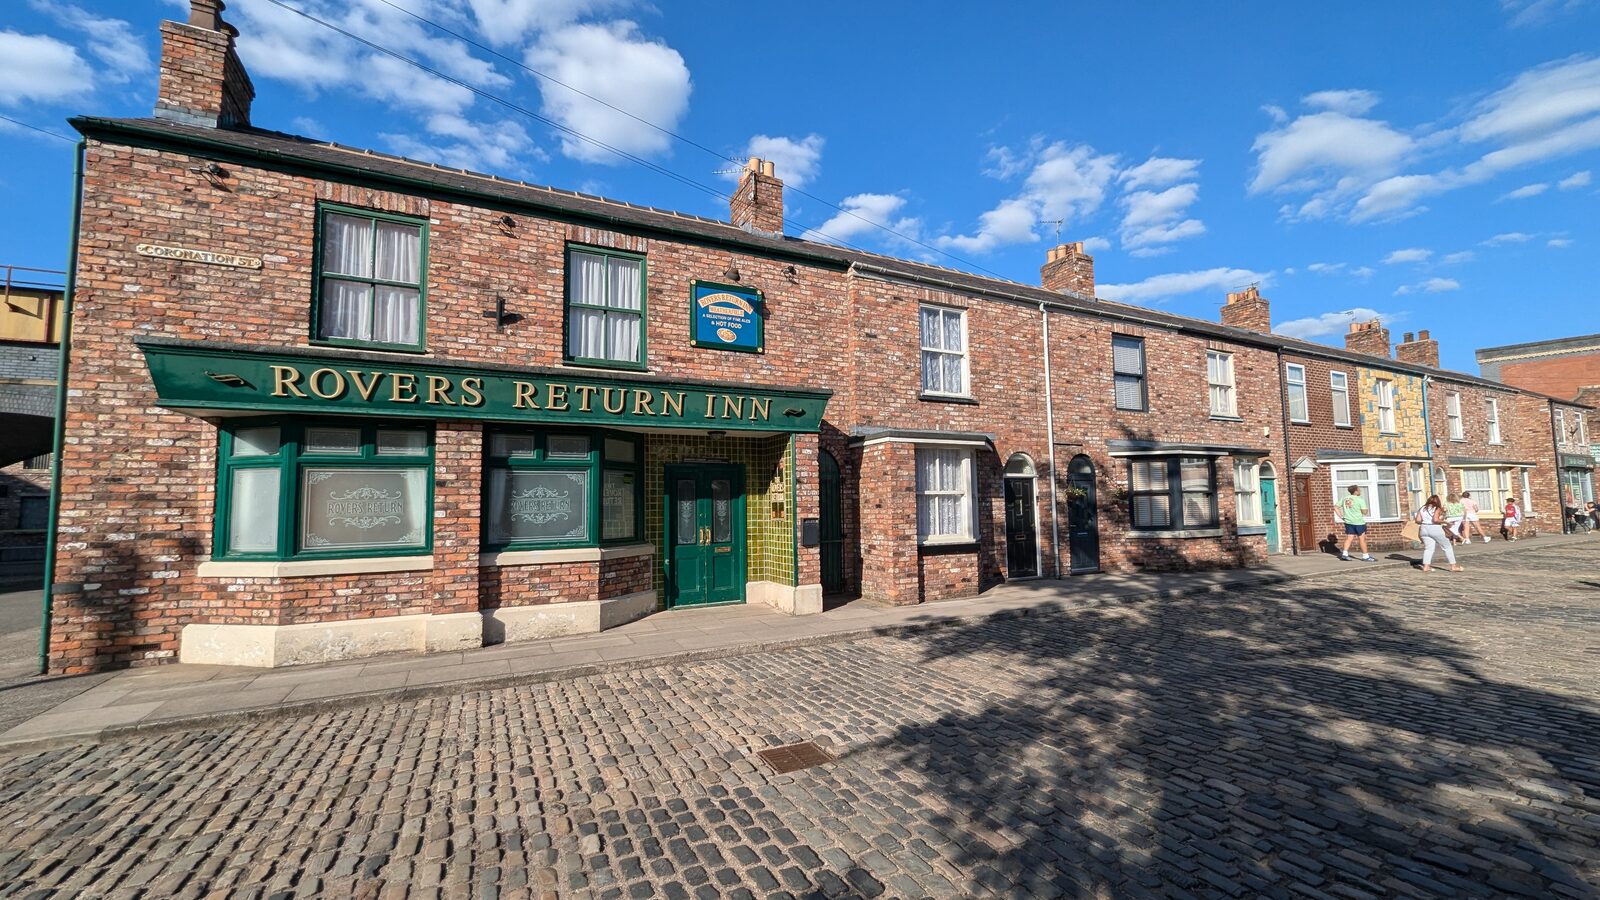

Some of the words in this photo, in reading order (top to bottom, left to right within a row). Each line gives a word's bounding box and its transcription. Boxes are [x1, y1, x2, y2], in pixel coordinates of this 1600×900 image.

[144, 245, 234, 265] CORONATION
[700, 294, 721, 306] ROVERS
[721, 294, 743, 306] RETURN
[270, 365, 483, 406] ROVERS
[513, 381, 685, 416] RETURN
[704, 394, 772, 420] INN
[328, 502, 363, 514] ROVERS
[367, 501, 403, 514] RETURN
[511, 499, 538, 511] ROVERS
[541, 499, 570, 511] RETURN
